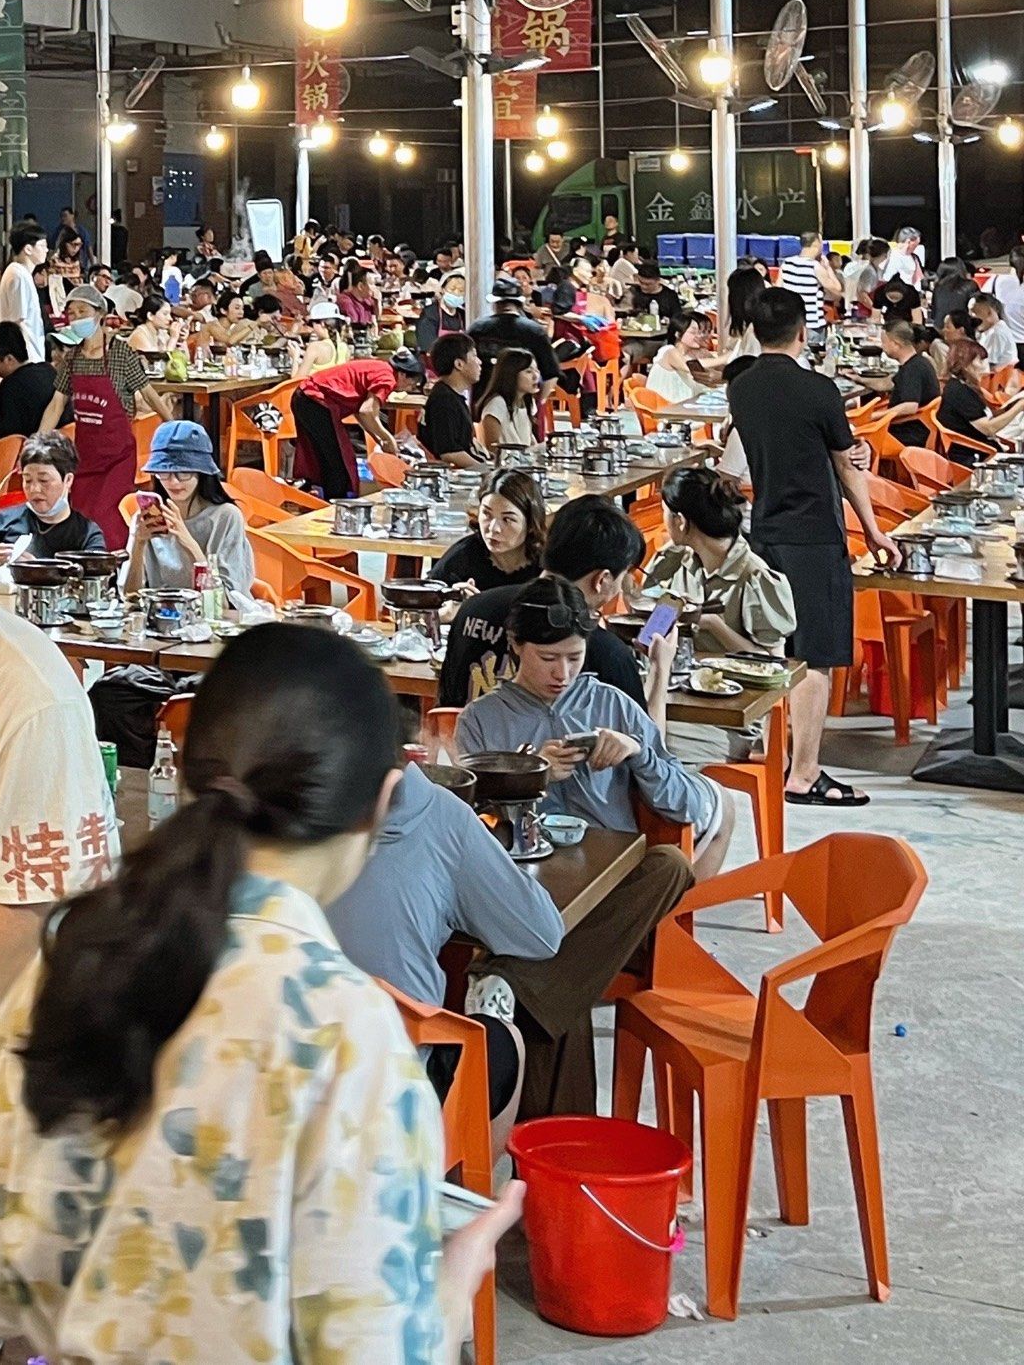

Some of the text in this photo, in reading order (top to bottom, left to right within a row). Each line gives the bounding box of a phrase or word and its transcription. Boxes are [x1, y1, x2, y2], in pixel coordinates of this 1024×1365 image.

[645, 188, 806, 223] 金鑫水产
[462, 616, 504, 645] NEW
